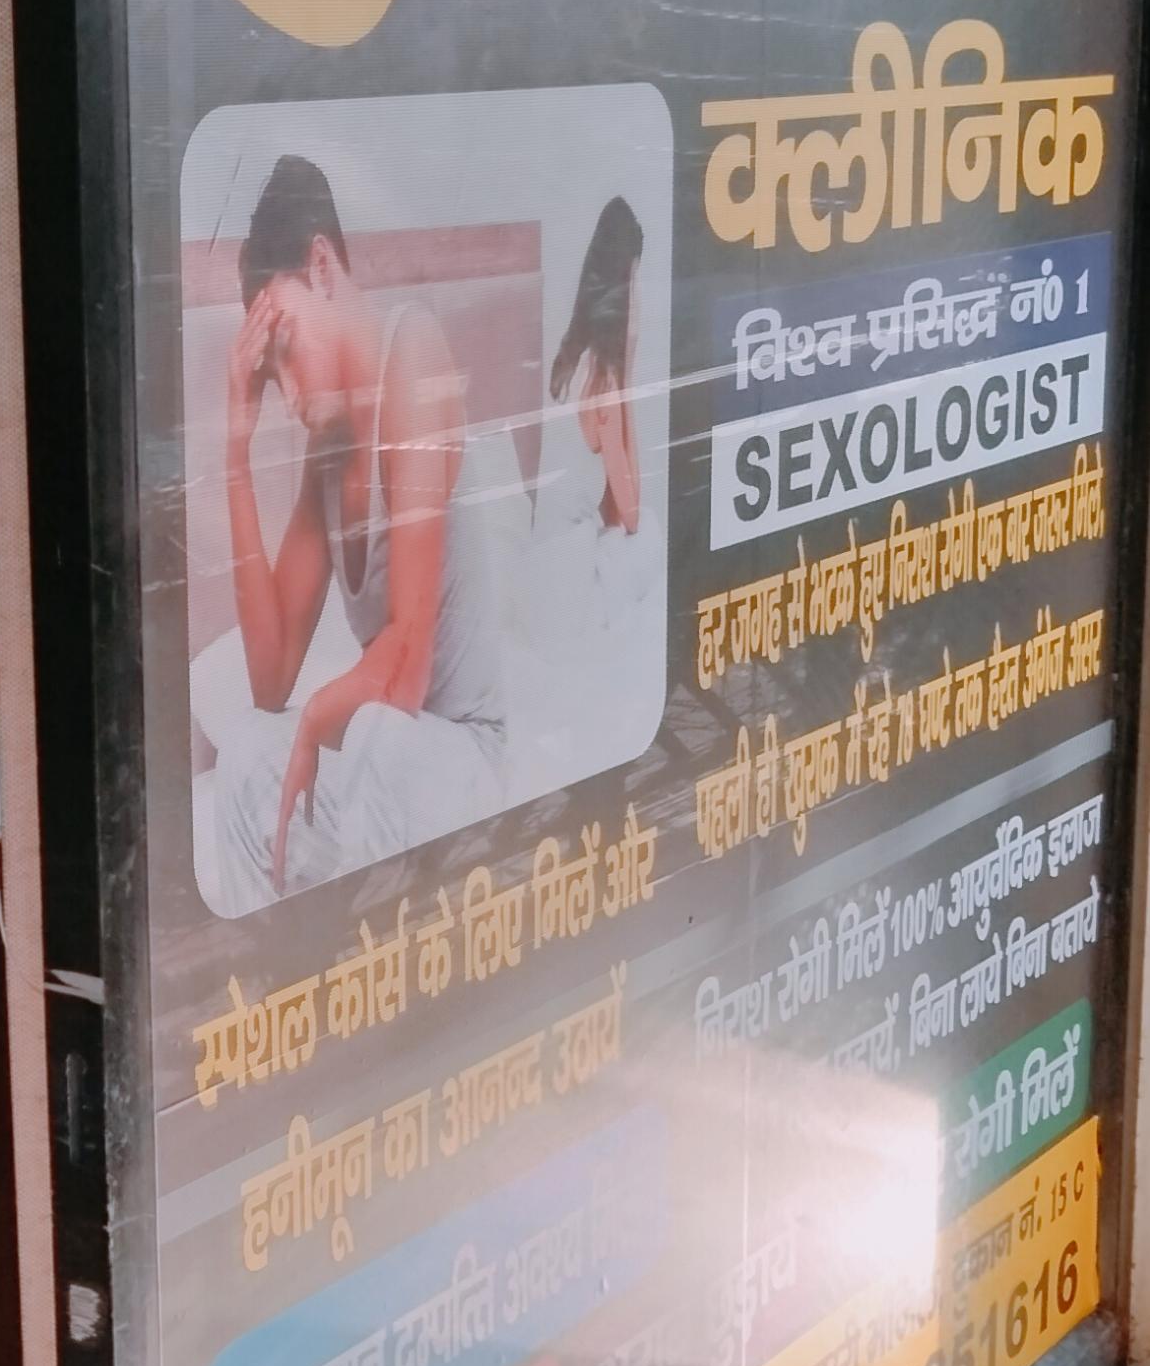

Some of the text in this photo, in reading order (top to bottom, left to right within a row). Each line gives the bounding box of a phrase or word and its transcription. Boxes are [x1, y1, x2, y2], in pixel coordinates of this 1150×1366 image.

[701, 18, 1115, 253] क्लीनिक
[731, 307, 857, 391] विश्व
[1075, 268, 1090, 315] 1
[732, 353, 1091, 523] SEXOLOGIST
[697, 591, 729, 691] हर
[729, 572, 785, 664] जगह
[786, 533, 807, 649] से
[809, 517, 857, 636] भटके
[858, 538, 887, 664] हुए
[888, 499, 938, 611] निराश
[939, 477, 976, 592] रोगी
[976, 500, 1006, 582] एक
[1006, 490, 1033, 565] बार
[1033, 477, 1073, 553] जरूर
[696, 725, 751, 860] पहली
[755, 713, 780, 839] ही
[783, 720, 842, 857] खुराक
[845, 675, 867, 786] में
[867, 668, 893, 783] रहे
[954, 658, 986, 739] तक
[1067, 608, 1105, 688] असर
[192, 802, 659, 1108] स्पेशल कोर्स के लिए मिलें और
[776, 916, 833, 1023] रोगी
[835, 885, 892, 991] मिलें
[889, 878, 945, 958] 100%
[1048, 793, 1105, 878] इलाज
[907, 972, 958, 1057] बिना
[960, 931, 1004, 1028] लाये
[1004, 915, 1050, 997] बिना
[1051, 874, 1102, 965] बताये
[240, 958, 628, 1272] हनीमून का आनन्द उठायें
[952, 1022, 1082, 1181] रोगी मिलें
[1049, 1171, 1068, 1225] 15
[1073, 1159, 1085, 1204] C
